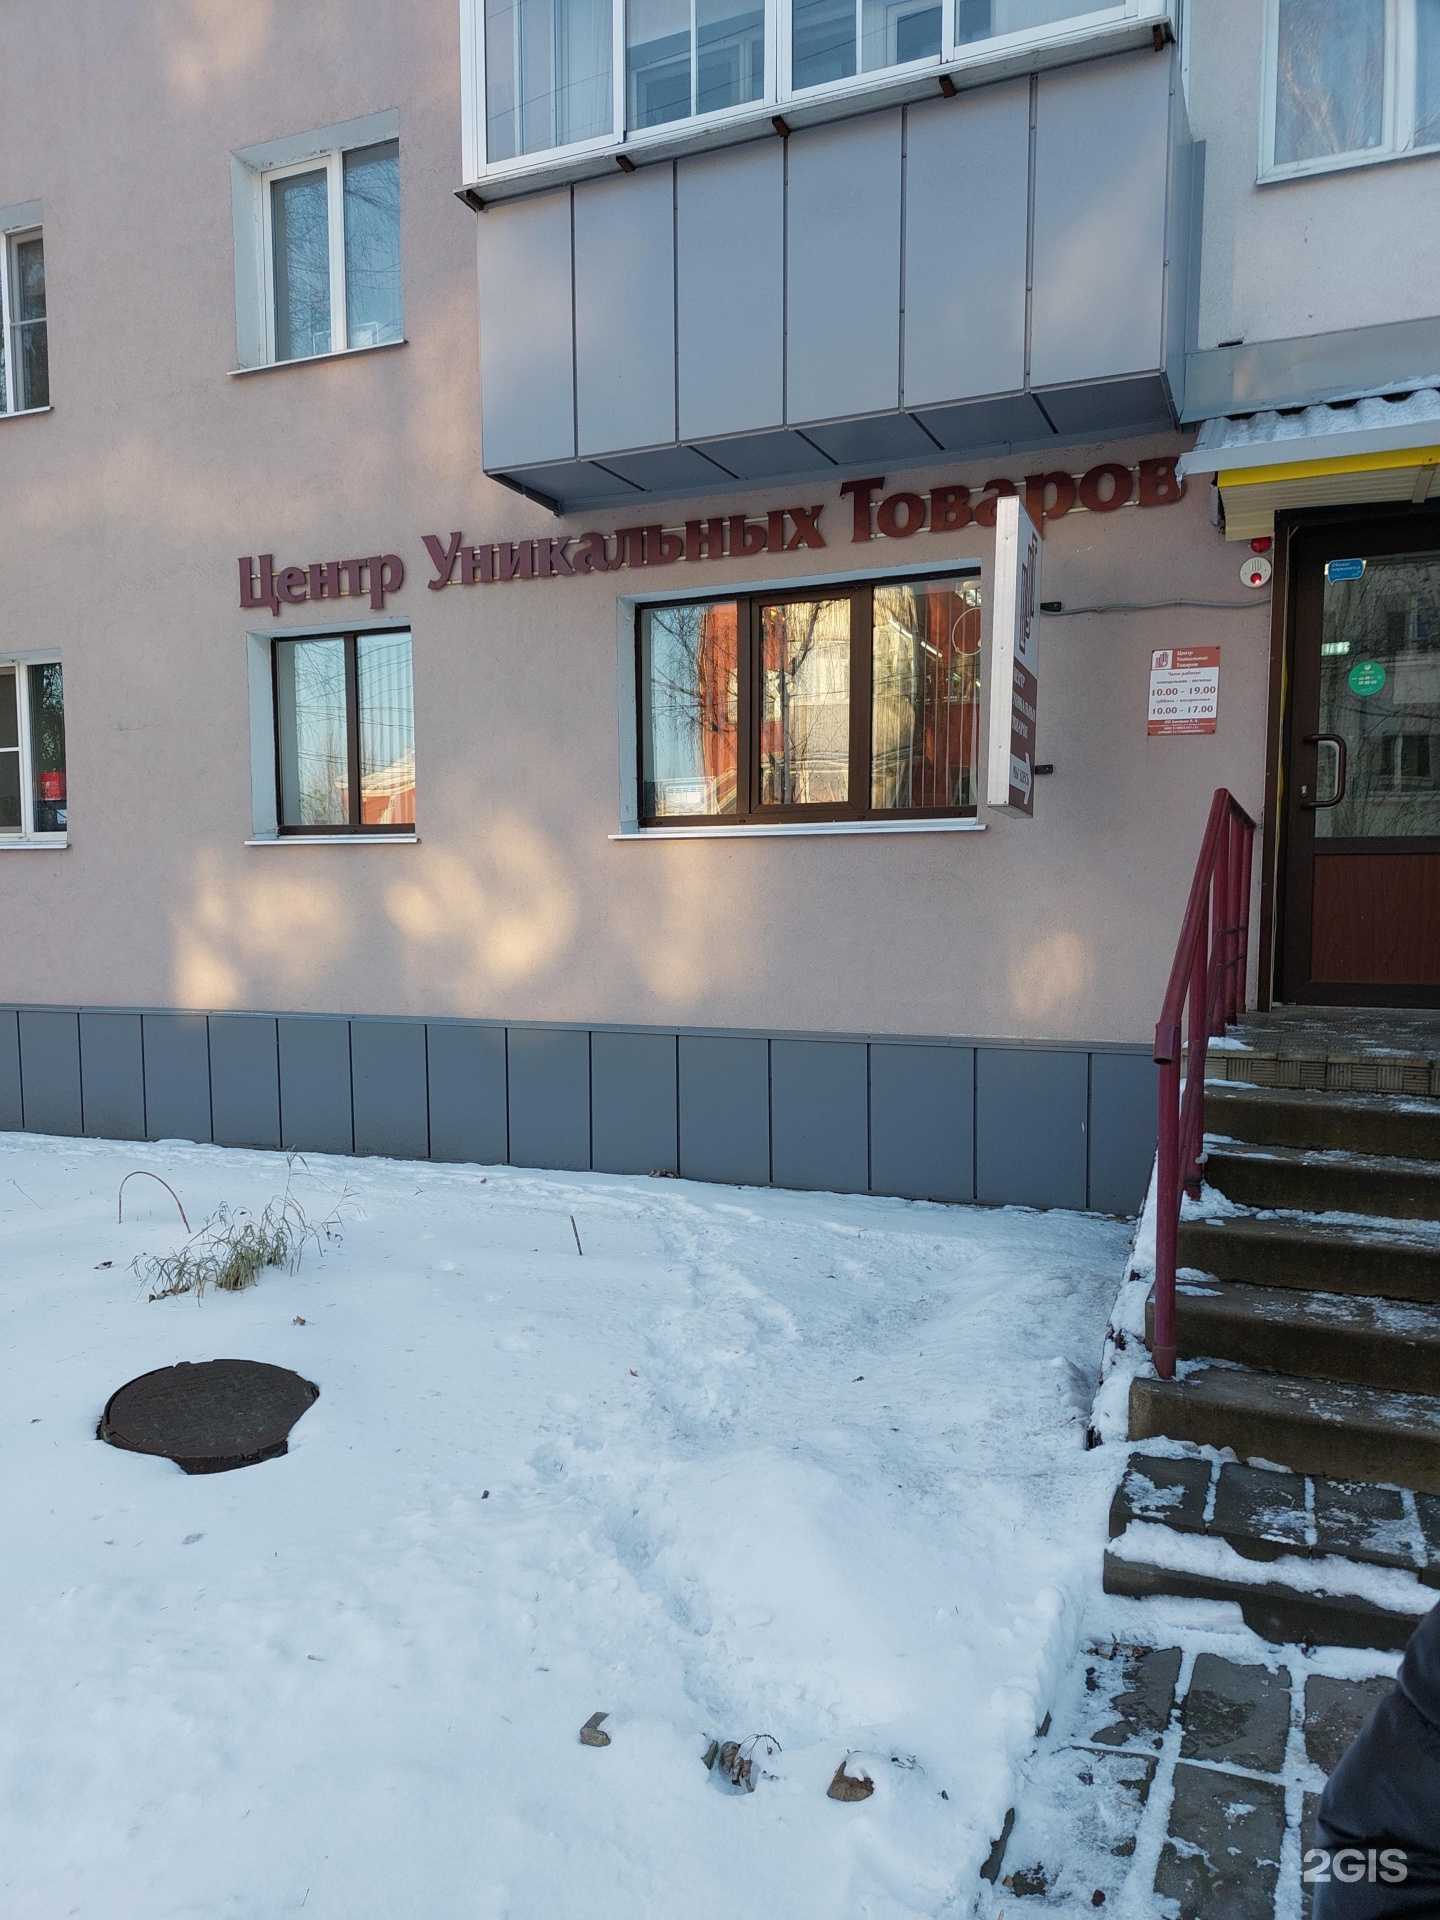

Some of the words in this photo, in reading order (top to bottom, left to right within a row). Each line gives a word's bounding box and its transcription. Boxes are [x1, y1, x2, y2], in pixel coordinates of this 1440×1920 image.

[238, 552, 405, 617] Центр
[421, 504, 827, 590] Уникальных
[840, 456, 1187, 543] Товаров
[1151, 687, 1178, 697] 10.00
[1189, 686, 1216, 695] 19.00
[1152, 706, 1178, 715] 10.00
[1187, 705, 1214, 714] 17.00
